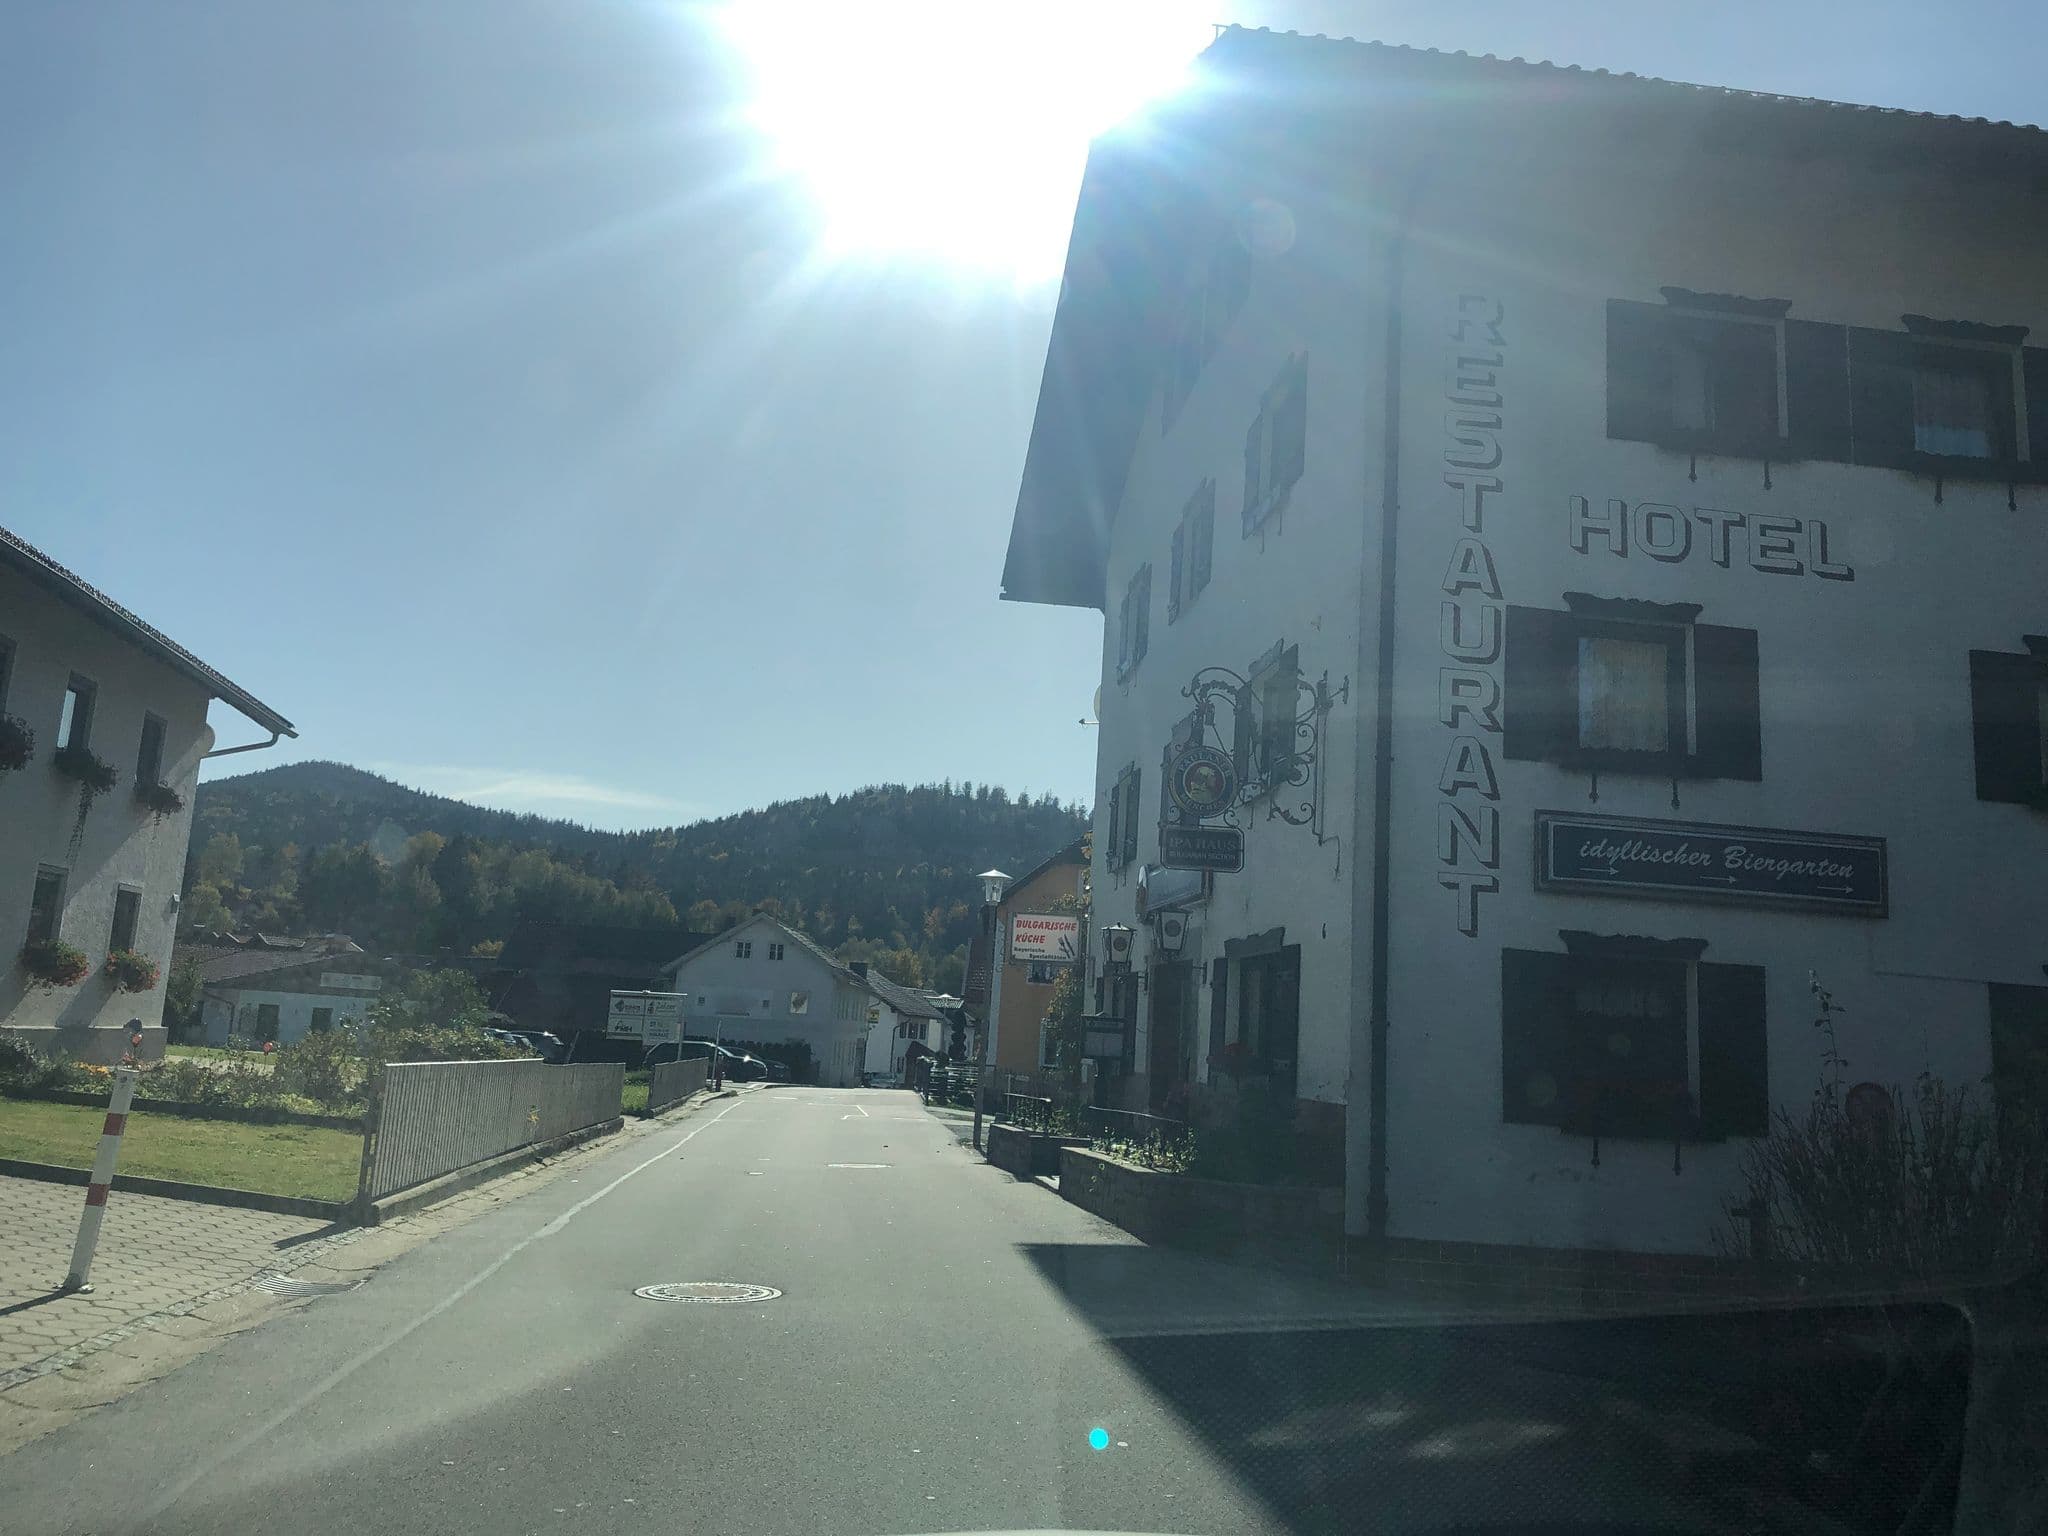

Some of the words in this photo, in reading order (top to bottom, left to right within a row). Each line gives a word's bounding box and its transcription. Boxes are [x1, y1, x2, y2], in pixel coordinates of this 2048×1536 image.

[1568, 495, 1855, 582] HOTEL
[1438, 294, 1506, 938] RESTAURANT
[1579, 837, 1713, 866] idyllischer
[1723, 845, 1855, 880] Biergarten
[1015, 932, 1046, 944] KÜCHE
[1016, 919, 1078, 931] BULGARISCHE
